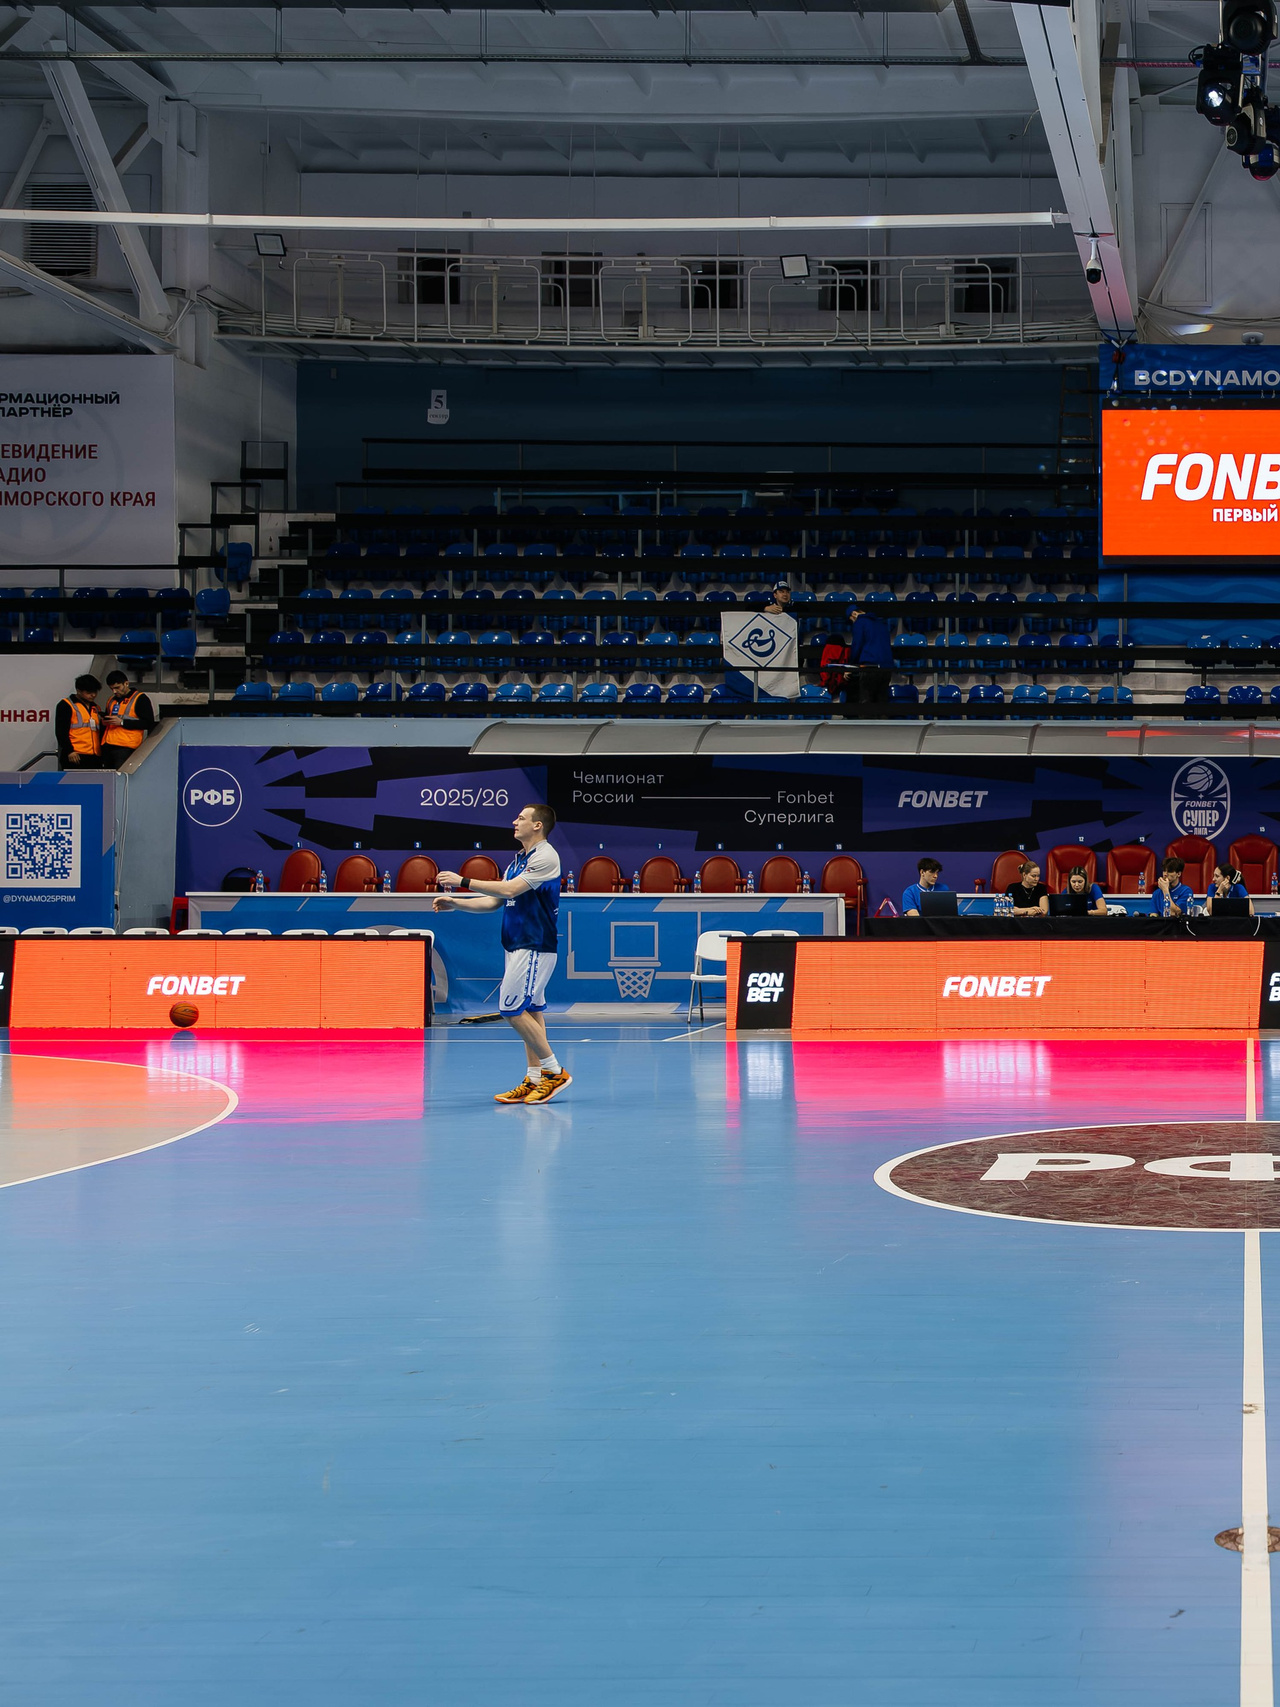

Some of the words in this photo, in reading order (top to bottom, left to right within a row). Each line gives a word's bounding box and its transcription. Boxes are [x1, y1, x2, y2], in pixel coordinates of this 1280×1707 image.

[434, 394, 444, 409] 5
[1, 444, 98, 462] ЕВИДЕНИЕ
[0, 491, 104, 507] МОРСКОГО
[110, 491, 156, 507] КРАЯ
[1212, 503, 1278, 522] ПЕРВЫЙ
[1, 709, 50, 722] нная
[573, 770, 664, 785] Чемпионат
[190, 788, 235, 806] РФБ
[420, 788, 509, 808] 2025/26
[573, 790, 634, 804] России
[777, 790, 834, 804] Fonbet
[898, 790, 988, 808] FONBET
[1185, 800, 1218, 808] FONBET
[744, 810, 834, 826] Суперлига
[1182, 809, 1220, 827] СУПЕР
[3, 894, 76, 903] @DYNAMO25PRIM
[147, 975, 245, 996] FONBET
[747, 972, 784, 987] FON
[943, 976, 1052, 998] FONBET
[746, 987, 784, 1003] BET
